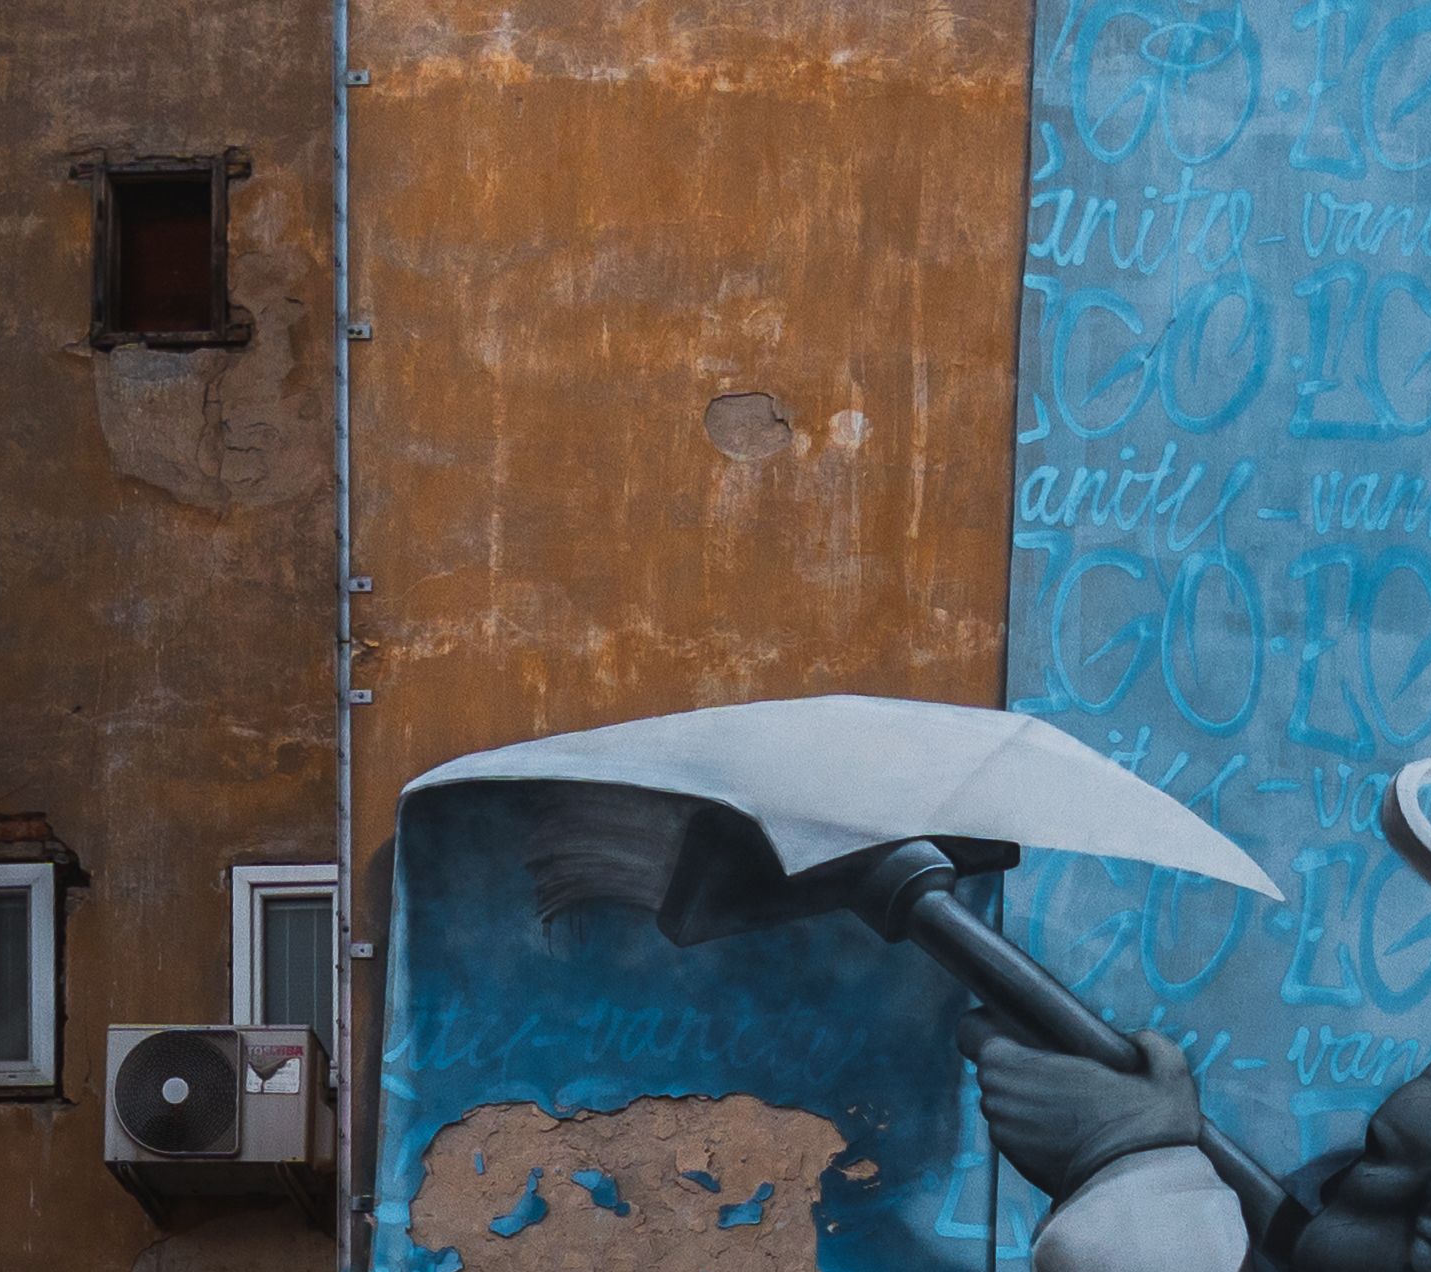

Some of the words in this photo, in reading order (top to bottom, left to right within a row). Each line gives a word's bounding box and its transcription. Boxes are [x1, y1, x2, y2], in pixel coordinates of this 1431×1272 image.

[1032, 0, 1264, 182] GO
[1029, 166, 1254, 278] anity
[1018, 440, 1258, 555] anity
